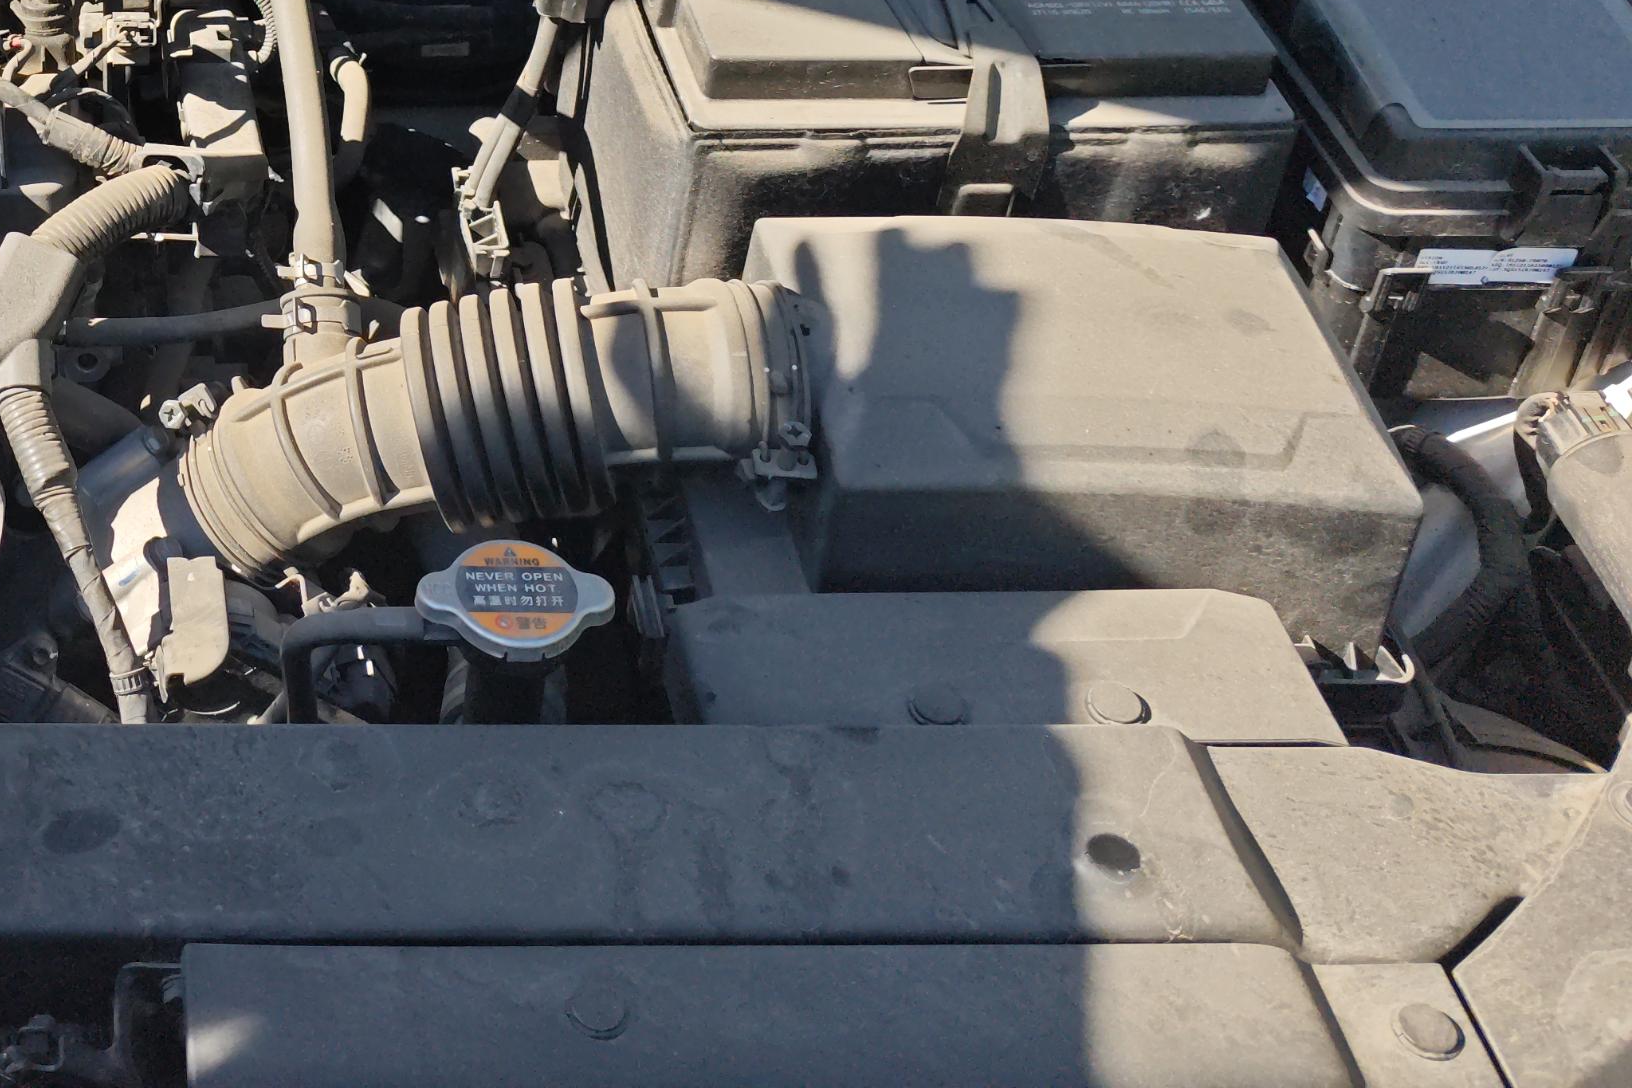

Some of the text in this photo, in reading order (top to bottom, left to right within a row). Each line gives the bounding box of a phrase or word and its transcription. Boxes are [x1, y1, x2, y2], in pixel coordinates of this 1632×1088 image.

[484, 557, 540, 566] WARNING
[465, 572, 564, 581] NEVER OPEN
[475, 584, 555, 593] WHEN HOT
[473, 595, 564, 607] 高温时勿打开
